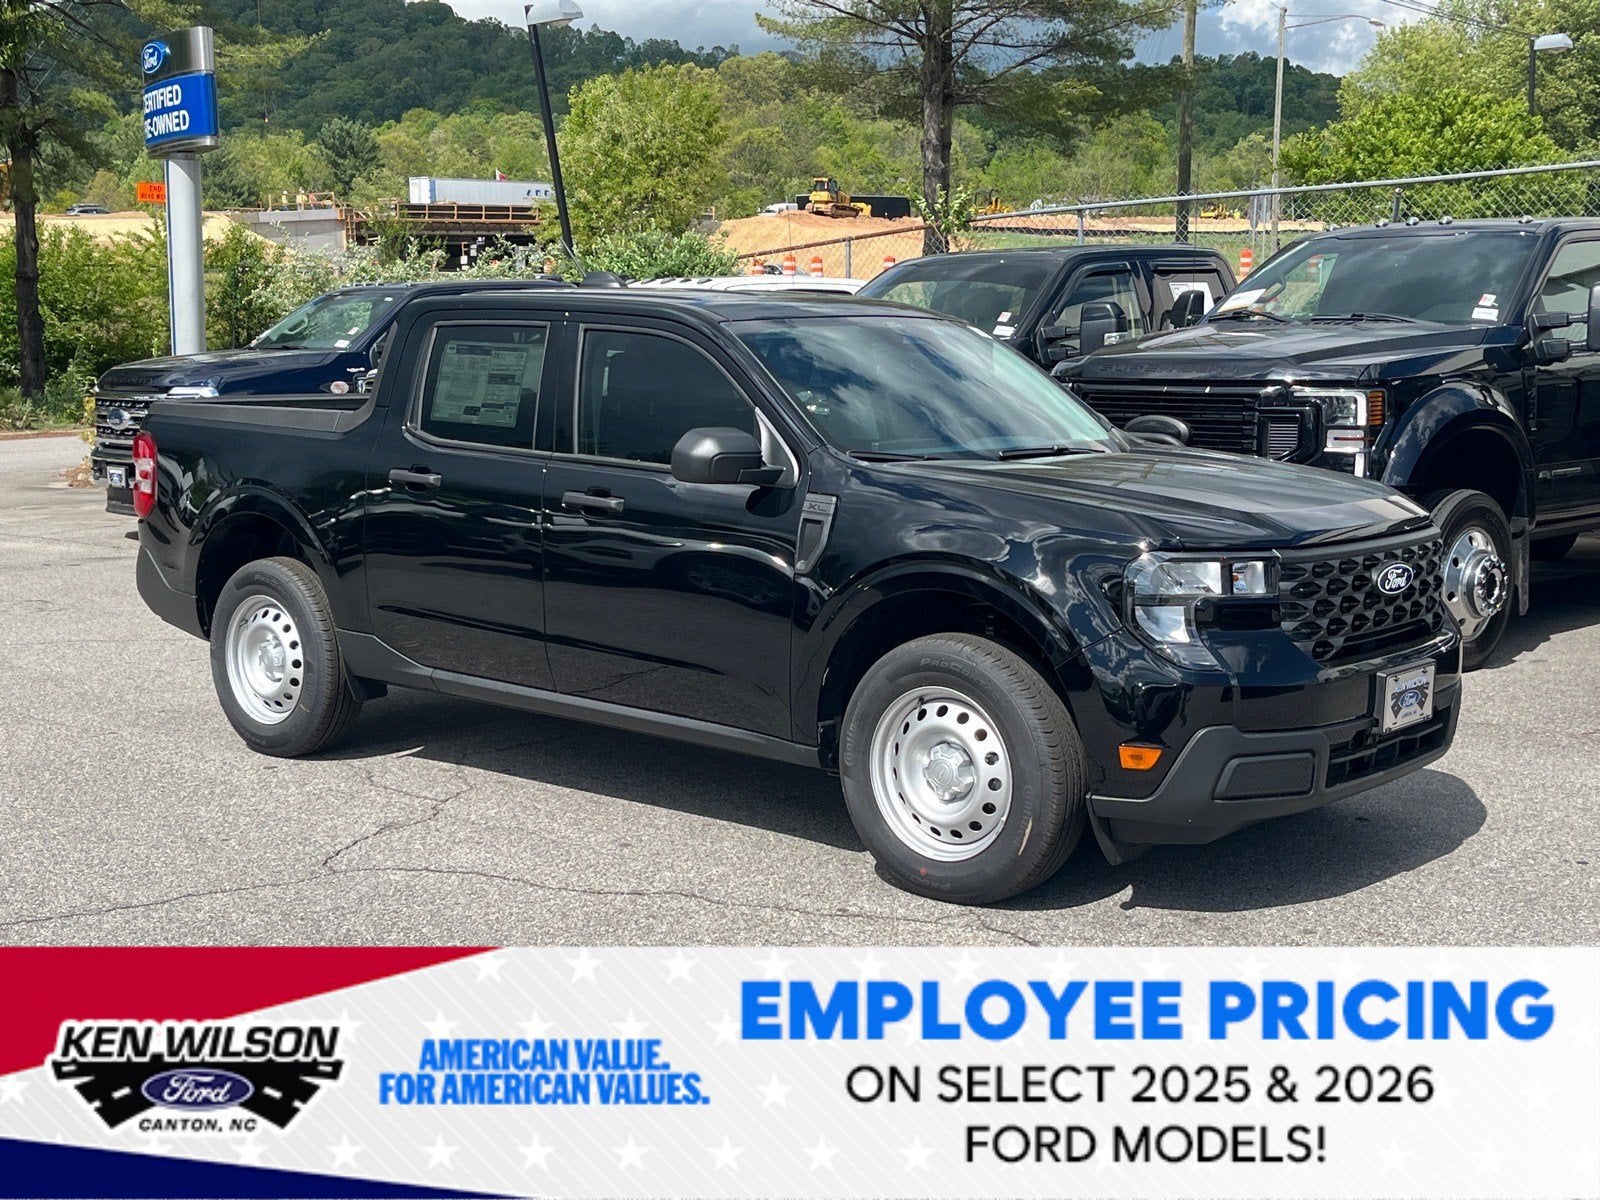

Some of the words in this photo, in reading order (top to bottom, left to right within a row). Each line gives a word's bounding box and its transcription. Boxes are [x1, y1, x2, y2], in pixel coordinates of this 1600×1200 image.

[144, 84, 182, 113] ERTIFIED
[808, 502, 827, 512] XL
[1385, 569, 1408, 590] Ford
